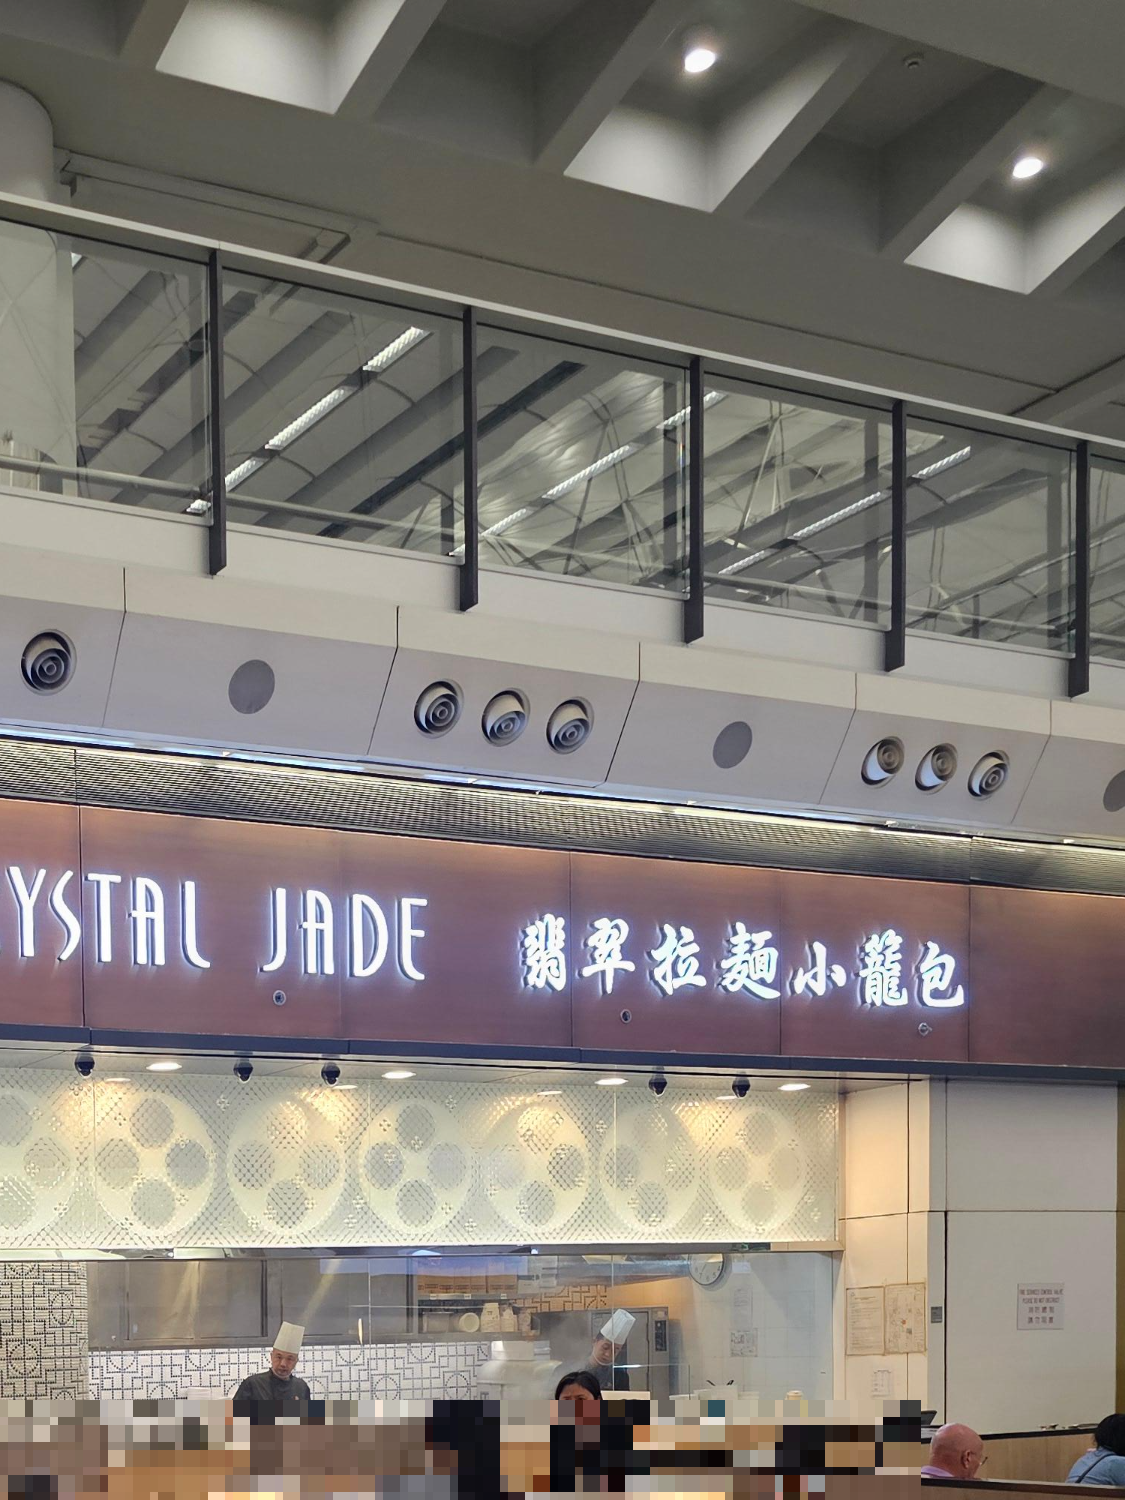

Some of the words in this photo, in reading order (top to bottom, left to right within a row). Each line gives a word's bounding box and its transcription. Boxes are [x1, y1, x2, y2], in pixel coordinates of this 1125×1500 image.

[260, 886, 428, 981] JADE
[523, 913, 964, 1008] 翡翠拉麵小籠包
